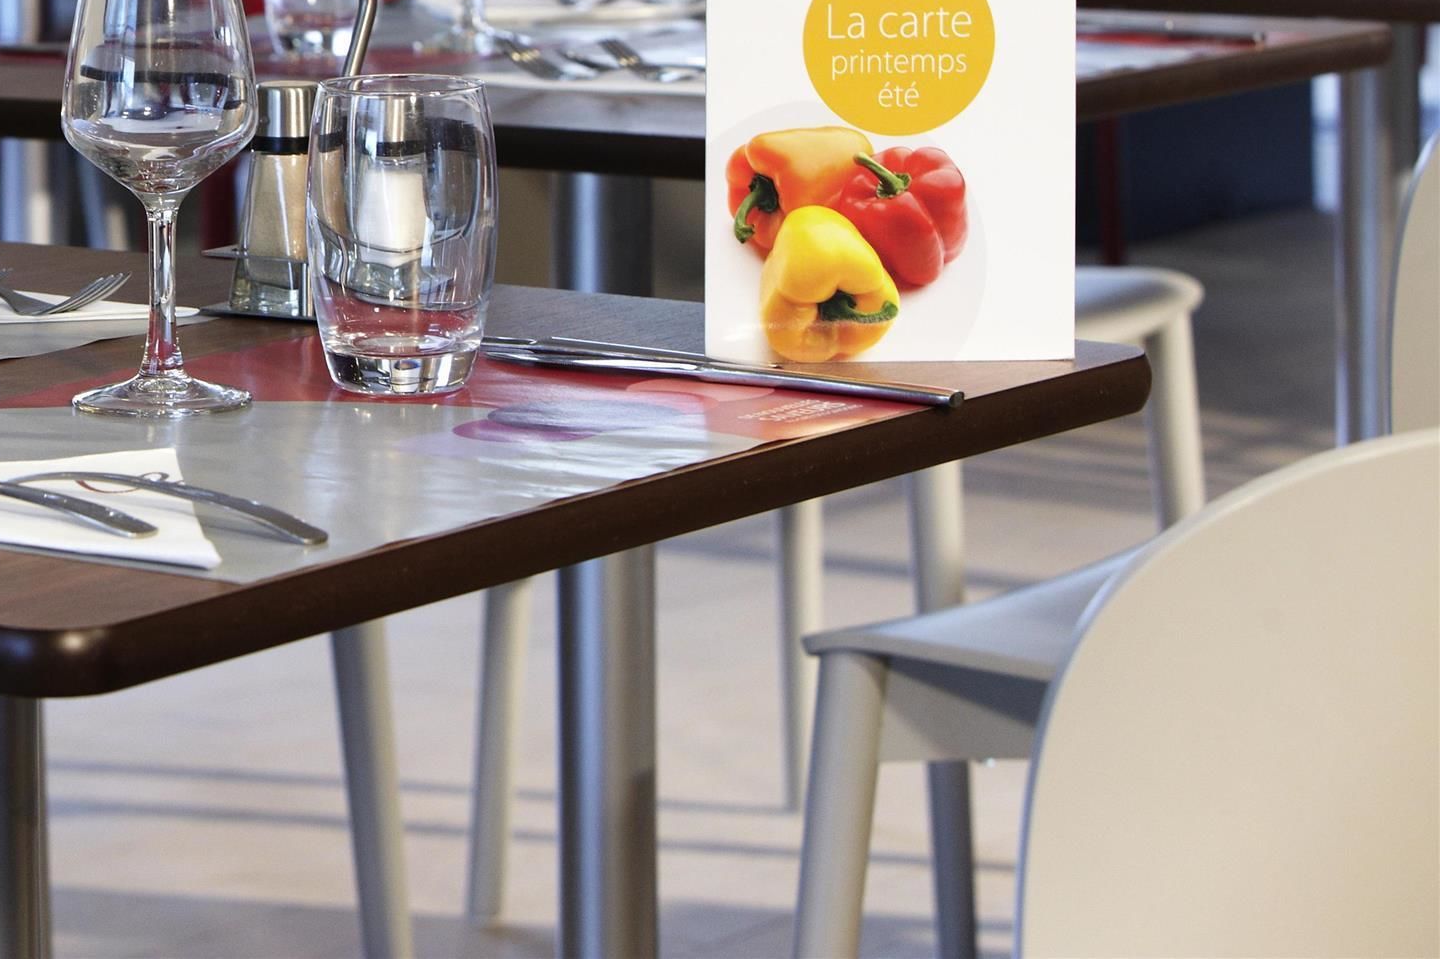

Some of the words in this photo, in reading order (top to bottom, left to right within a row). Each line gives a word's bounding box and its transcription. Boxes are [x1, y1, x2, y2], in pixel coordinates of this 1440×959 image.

[827, 4, 865, 40] La
[878, 7, 972, 39] carte
[831, 52, 967, 80] printemps
[878, 81, 920, 108] été
